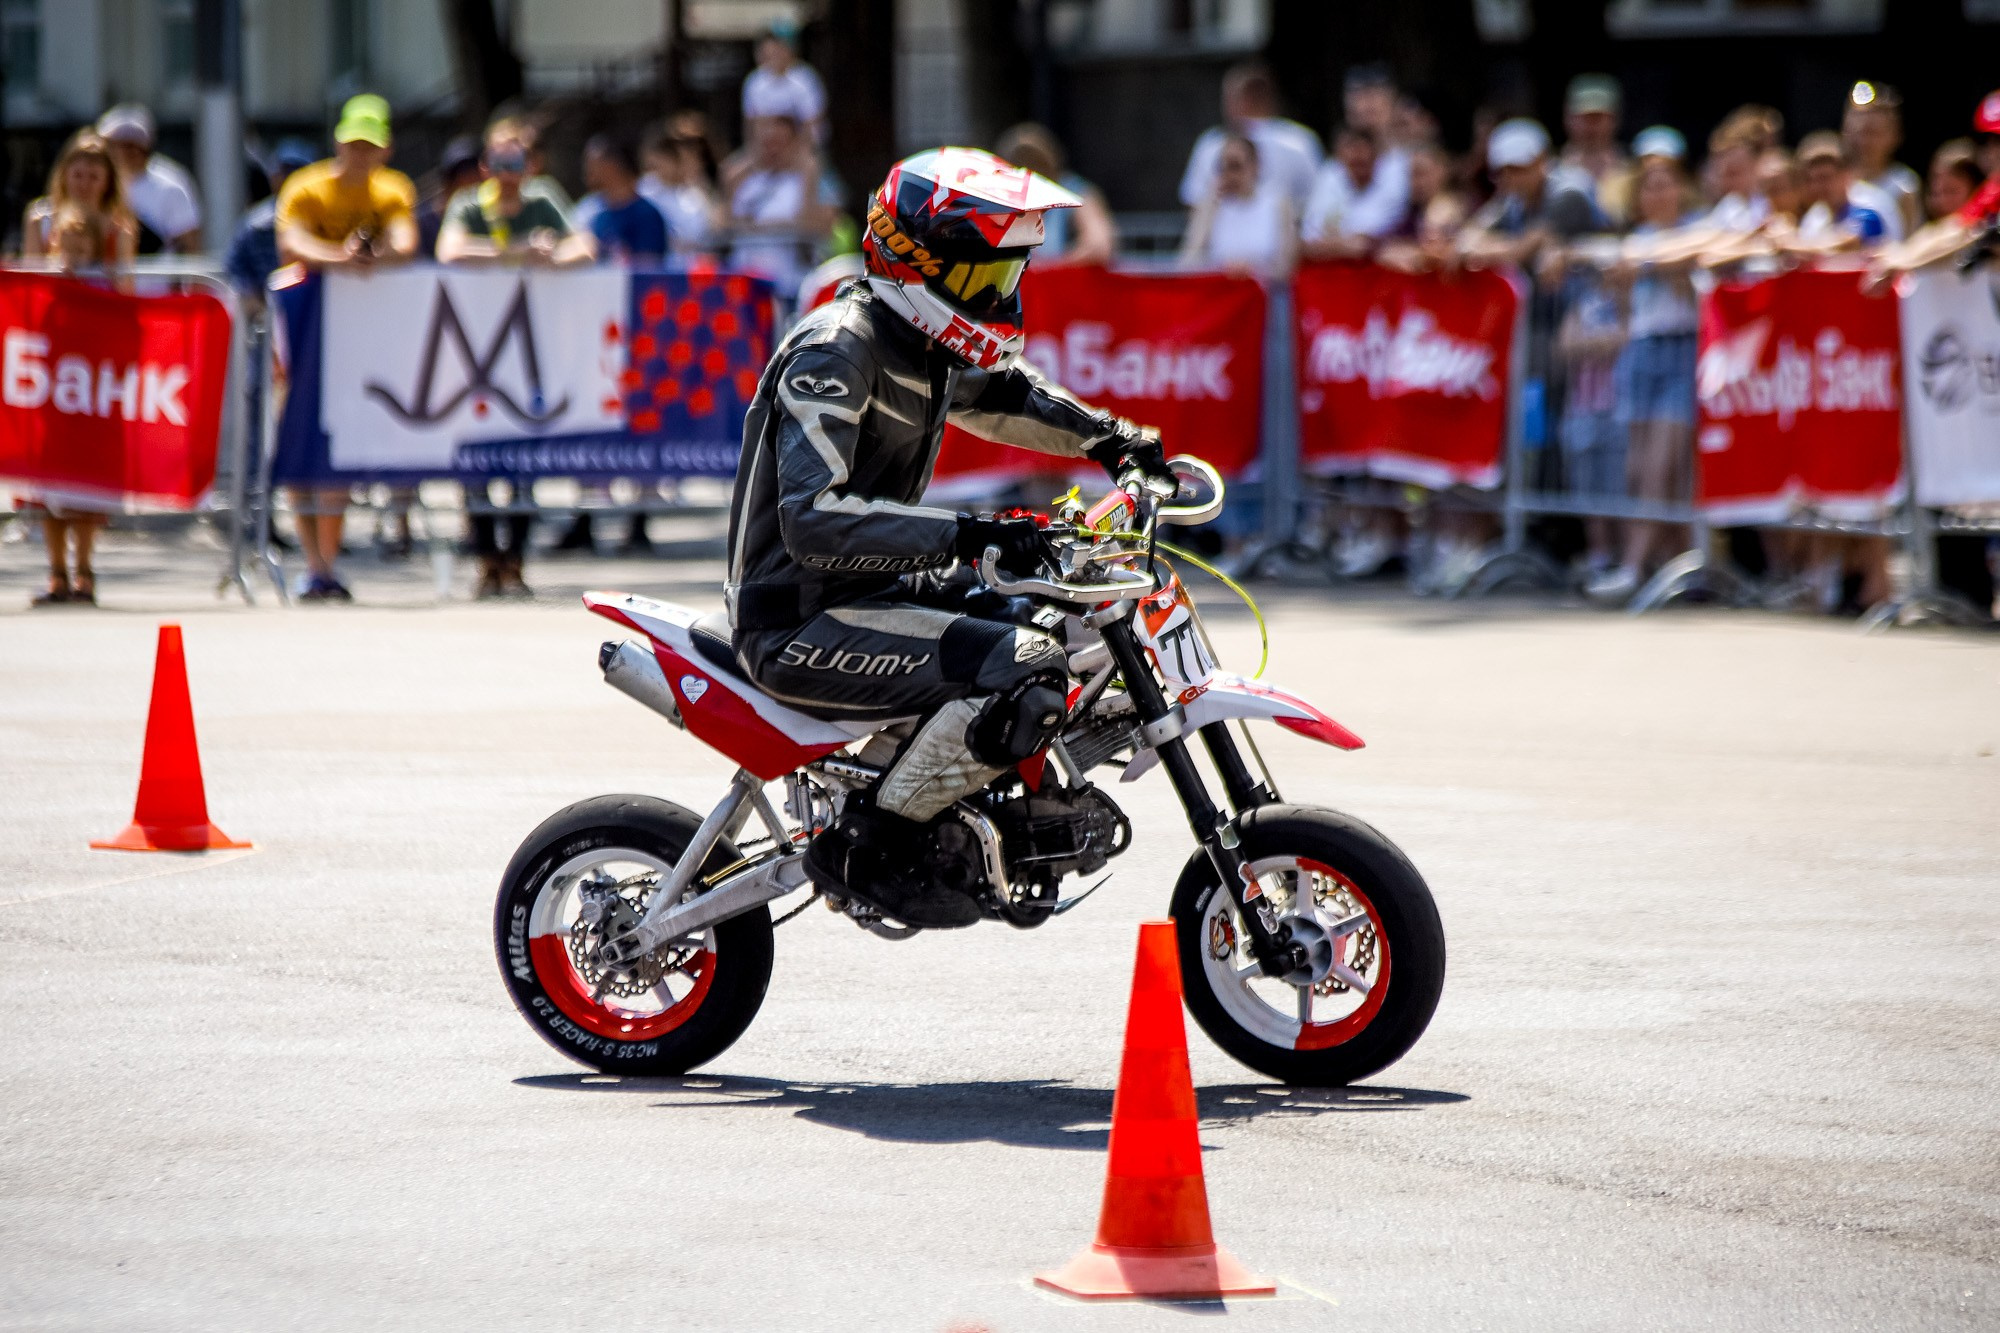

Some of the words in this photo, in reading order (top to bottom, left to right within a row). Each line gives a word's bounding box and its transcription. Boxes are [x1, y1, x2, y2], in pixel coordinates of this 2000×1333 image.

[867, 205, 944, 277] 100%
[911, 315, 967, 357] RACING
[3, 326, 189, 427] Банк
[802, 553, 946, 572] SUOMY
[777, 641, 931, 676] SUOMY
[1157, 615, 1212, 685] 77
[508, 904, 533, 984] Mitas
[531, 996, 555, 1017] 2.0
[617, 1042, 659, 1059] MC35
